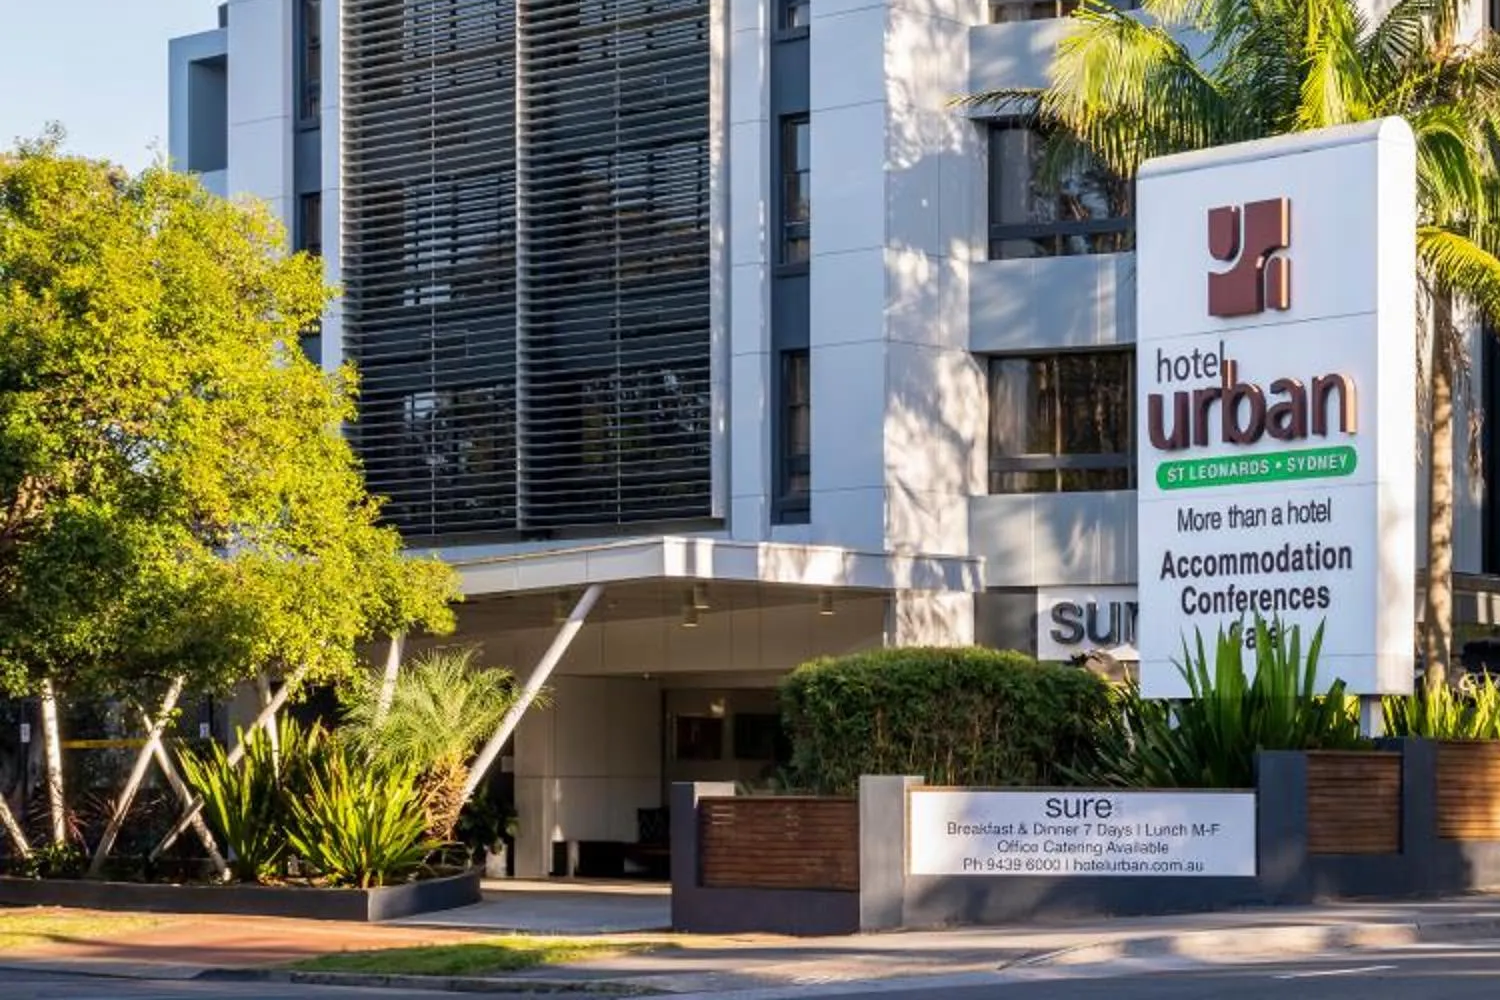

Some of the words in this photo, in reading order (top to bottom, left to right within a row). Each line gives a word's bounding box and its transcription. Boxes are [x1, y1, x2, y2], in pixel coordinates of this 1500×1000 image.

[1157, 340, 1225, 383] hotel
[1148, 359, 1357, 451] urban
[1167, 467, 1185, 483] ST
[1189, 459, 1270, 481] LEONARDS
[1287, 453, 1348, 473] SYDNEY
[1177, 507, 1222, 533] More
[1228, 503, 1266, 529] than
[1271, 506, 1283, 526] a
[1287, 497, 1332, 525] hotel
[1160, 541, 1352, 581] Accommodation
[1181, 583, 1331, 616] Conferences
[1045, 796, 1113, 819] sure
[947, 821, 1013, 835] Breakfast
[1017, 821, 1028, 836] &
[1033, 822, 1079, 836] Dinner
[1083, 823, 1092, 836] 7
[1097, 823, 1133, 838] Days
[1145, 823, 1187, 837] Lunch
[1191, 823, 1221, 837] M-F
[997, 839, 1039, 854] Office
[1043, 839, 1103, 857] Catering
[1106, 840, 1169, 854] Available
[963, 857, 983, 871] Ph
[987, 857, 1022, 871] 9439
[1025, 857, 1061, 871] 6000
[1073, 858, 1204, 873] hotelurban.com.au
